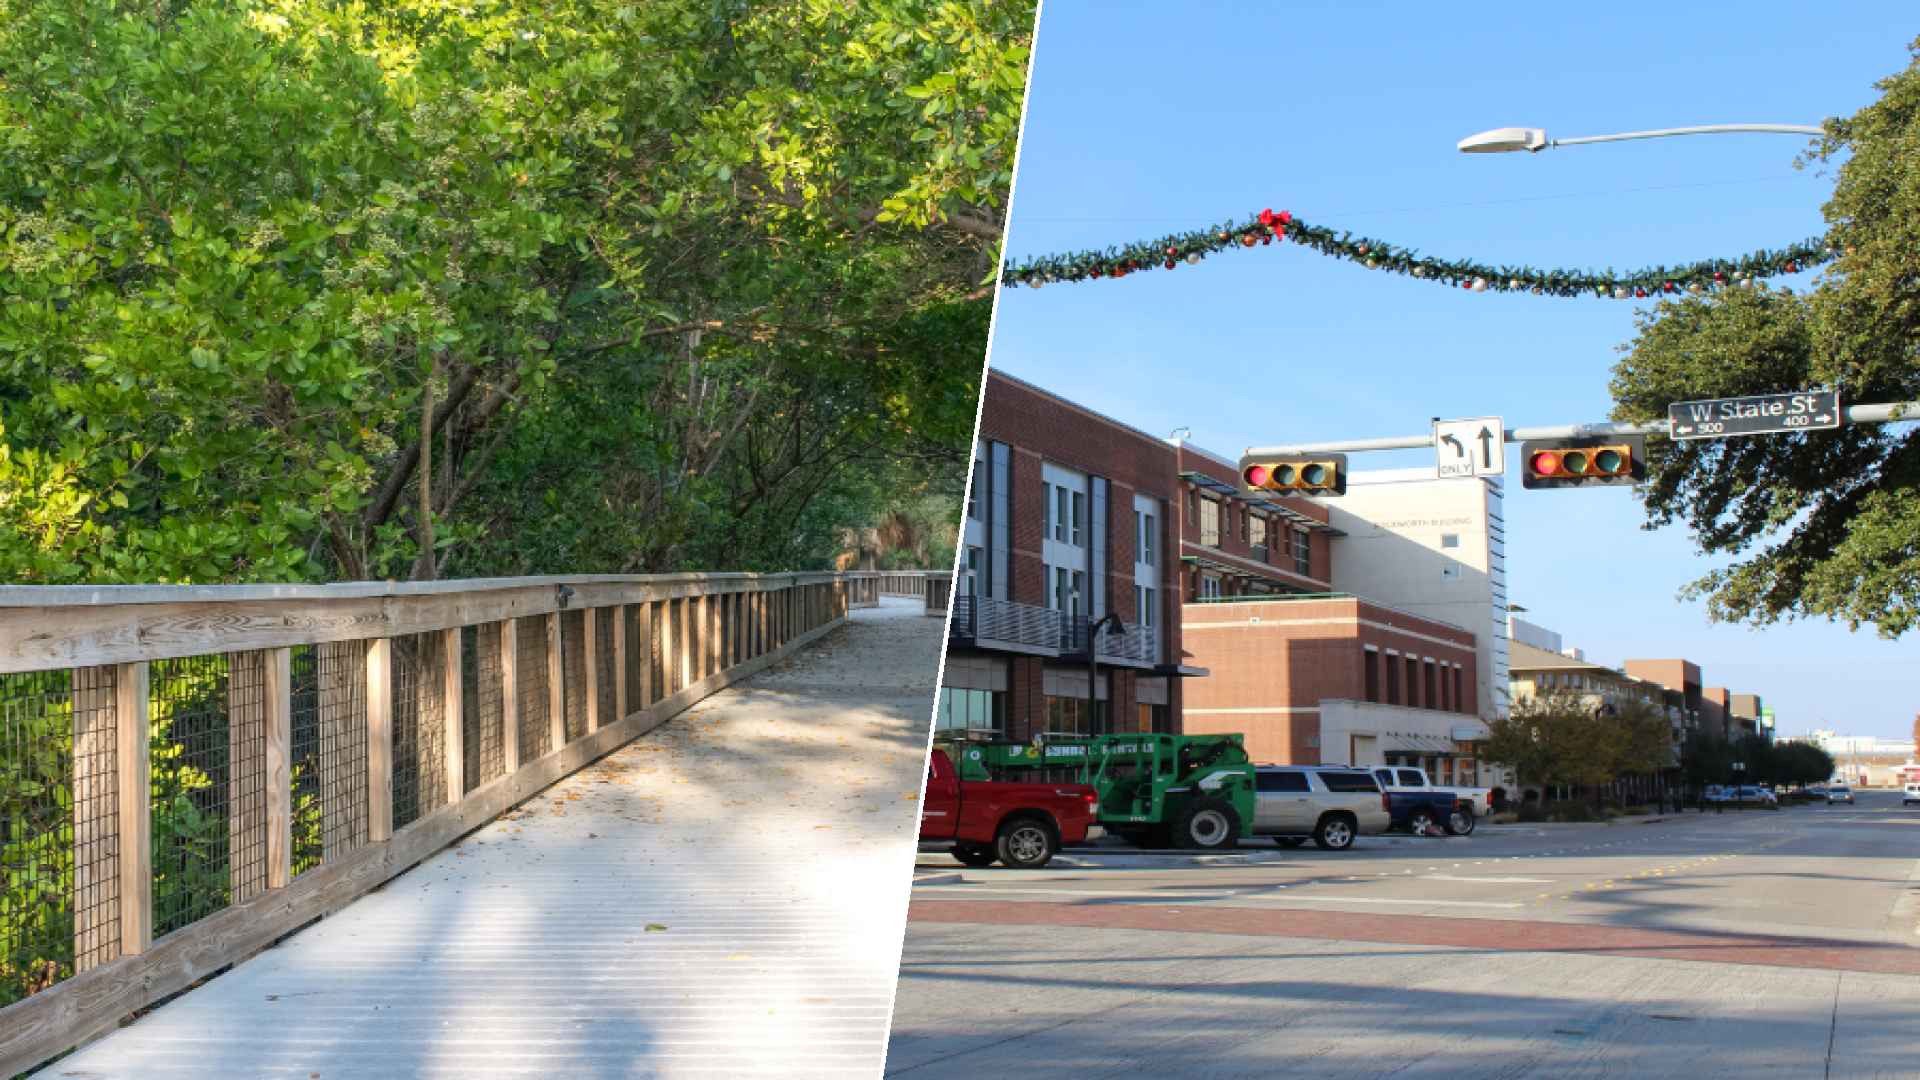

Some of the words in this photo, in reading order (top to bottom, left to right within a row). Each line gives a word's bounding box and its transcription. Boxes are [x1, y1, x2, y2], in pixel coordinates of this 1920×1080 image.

[1689, 404, 1713, 422] W
[1720, 399, 1785, 421] State
[1790, 395, 1817, 415] St
[1783, 415, 1809, 427] 400
[1697, 422, 1724, 434] 500
[1440, 463, 1472, 475] ONLY
